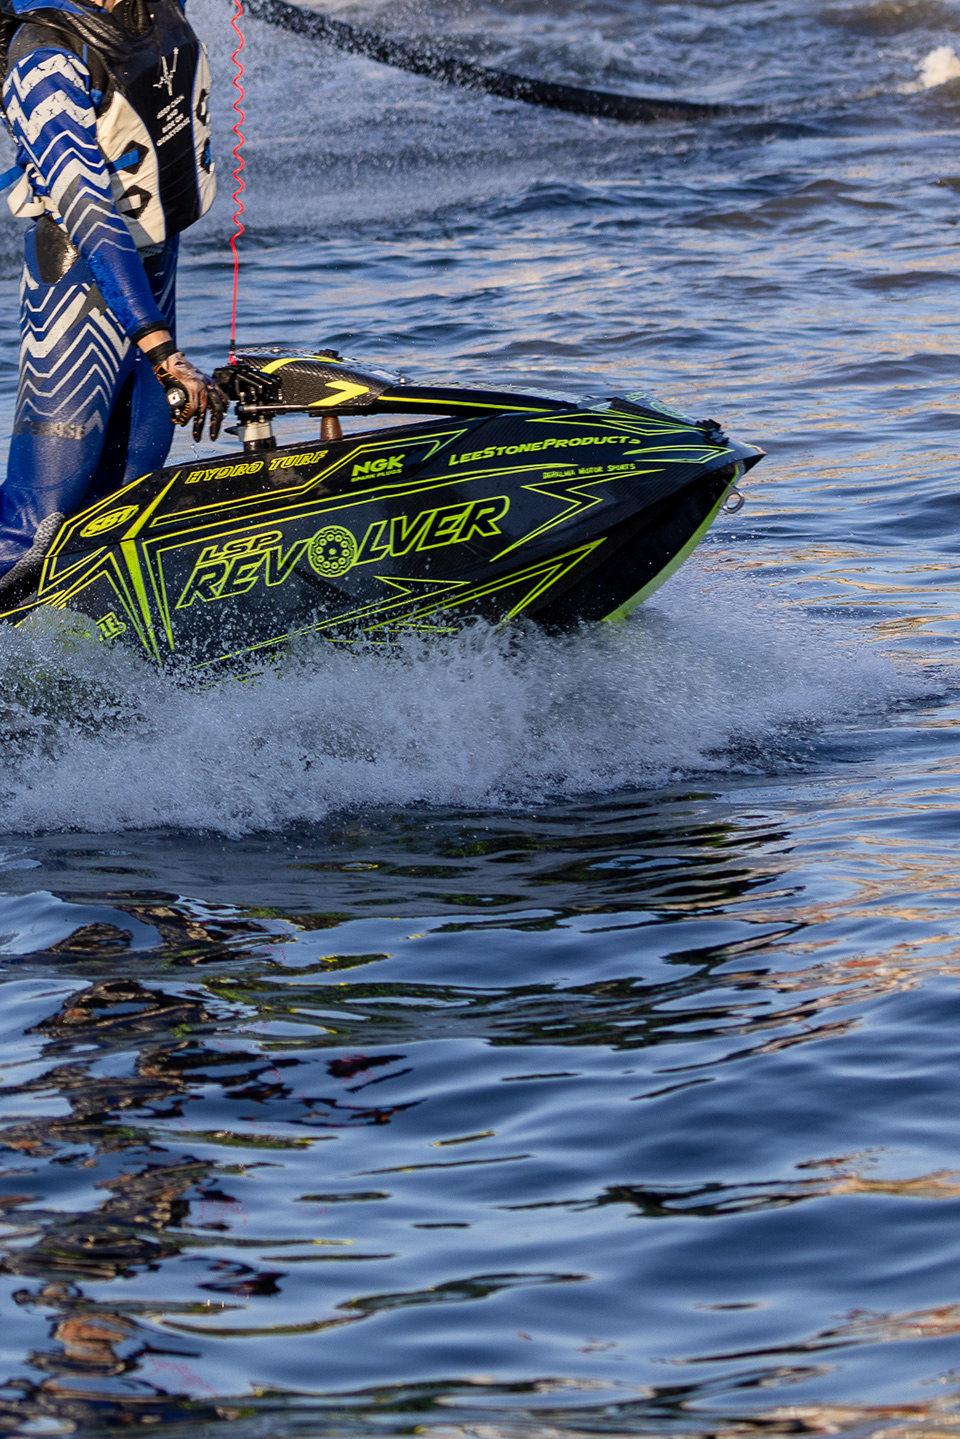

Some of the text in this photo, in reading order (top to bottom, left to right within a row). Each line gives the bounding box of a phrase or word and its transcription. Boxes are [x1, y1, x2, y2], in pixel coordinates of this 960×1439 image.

[184, 449, 329, 485] HYDRO TURF
[351, 453, 406, 477] NGK
[606, 462, 637, 473] SPORTS
[195, 530, 283, 567] LSP
